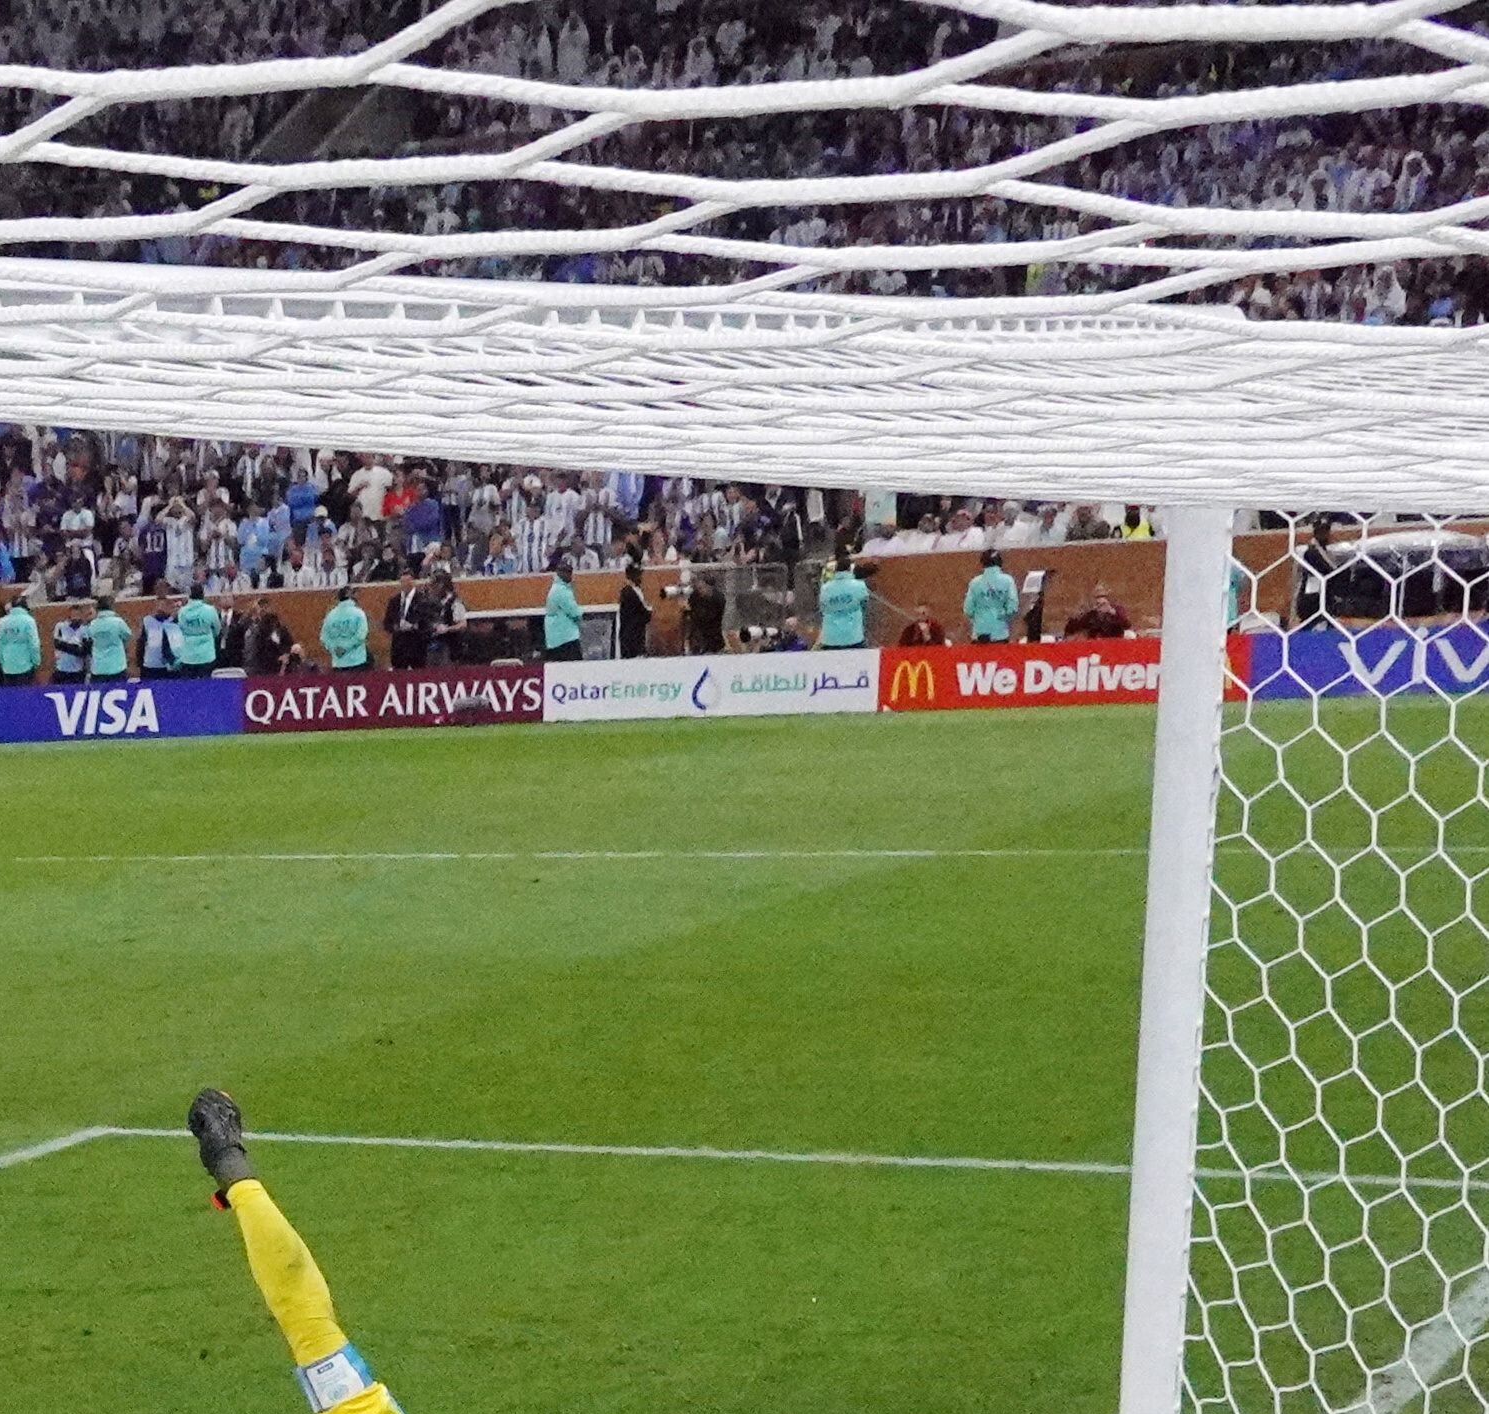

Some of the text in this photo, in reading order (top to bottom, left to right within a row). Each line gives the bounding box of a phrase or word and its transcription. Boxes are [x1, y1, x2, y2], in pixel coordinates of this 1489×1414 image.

[551, 680, 682, 705] QatarEnergy
[810, 670, 870, 697] قطر
[955, 660, 1018, 697] We
[43, 687, 160, 737] VISA
[244, 676, 542, 725] QATAR AIRWAYS
